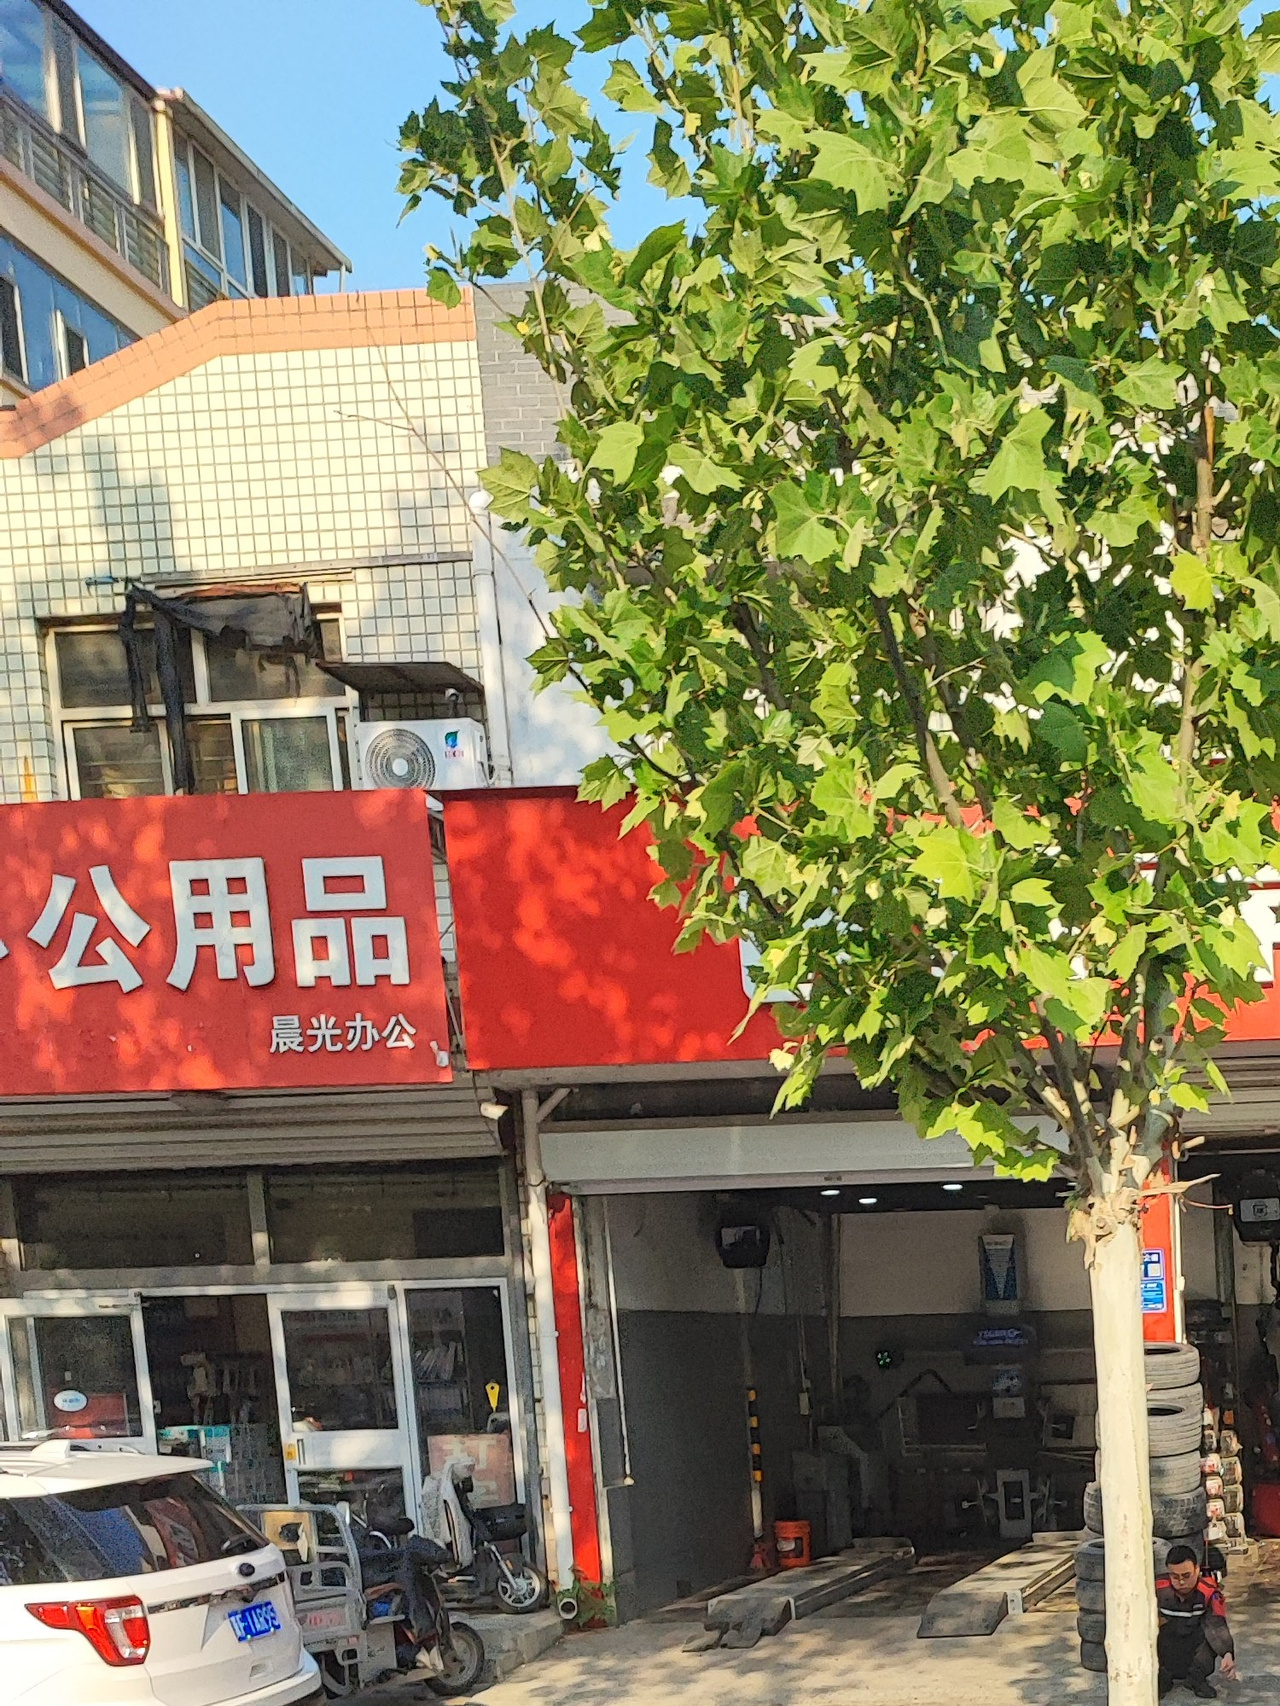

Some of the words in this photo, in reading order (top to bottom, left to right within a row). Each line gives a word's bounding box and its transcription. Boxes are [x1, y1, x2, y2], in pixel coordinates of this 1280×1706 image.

[0, 855, 410, 993] 公用品
[269, 1012, 418, 1055] 晨光办公
